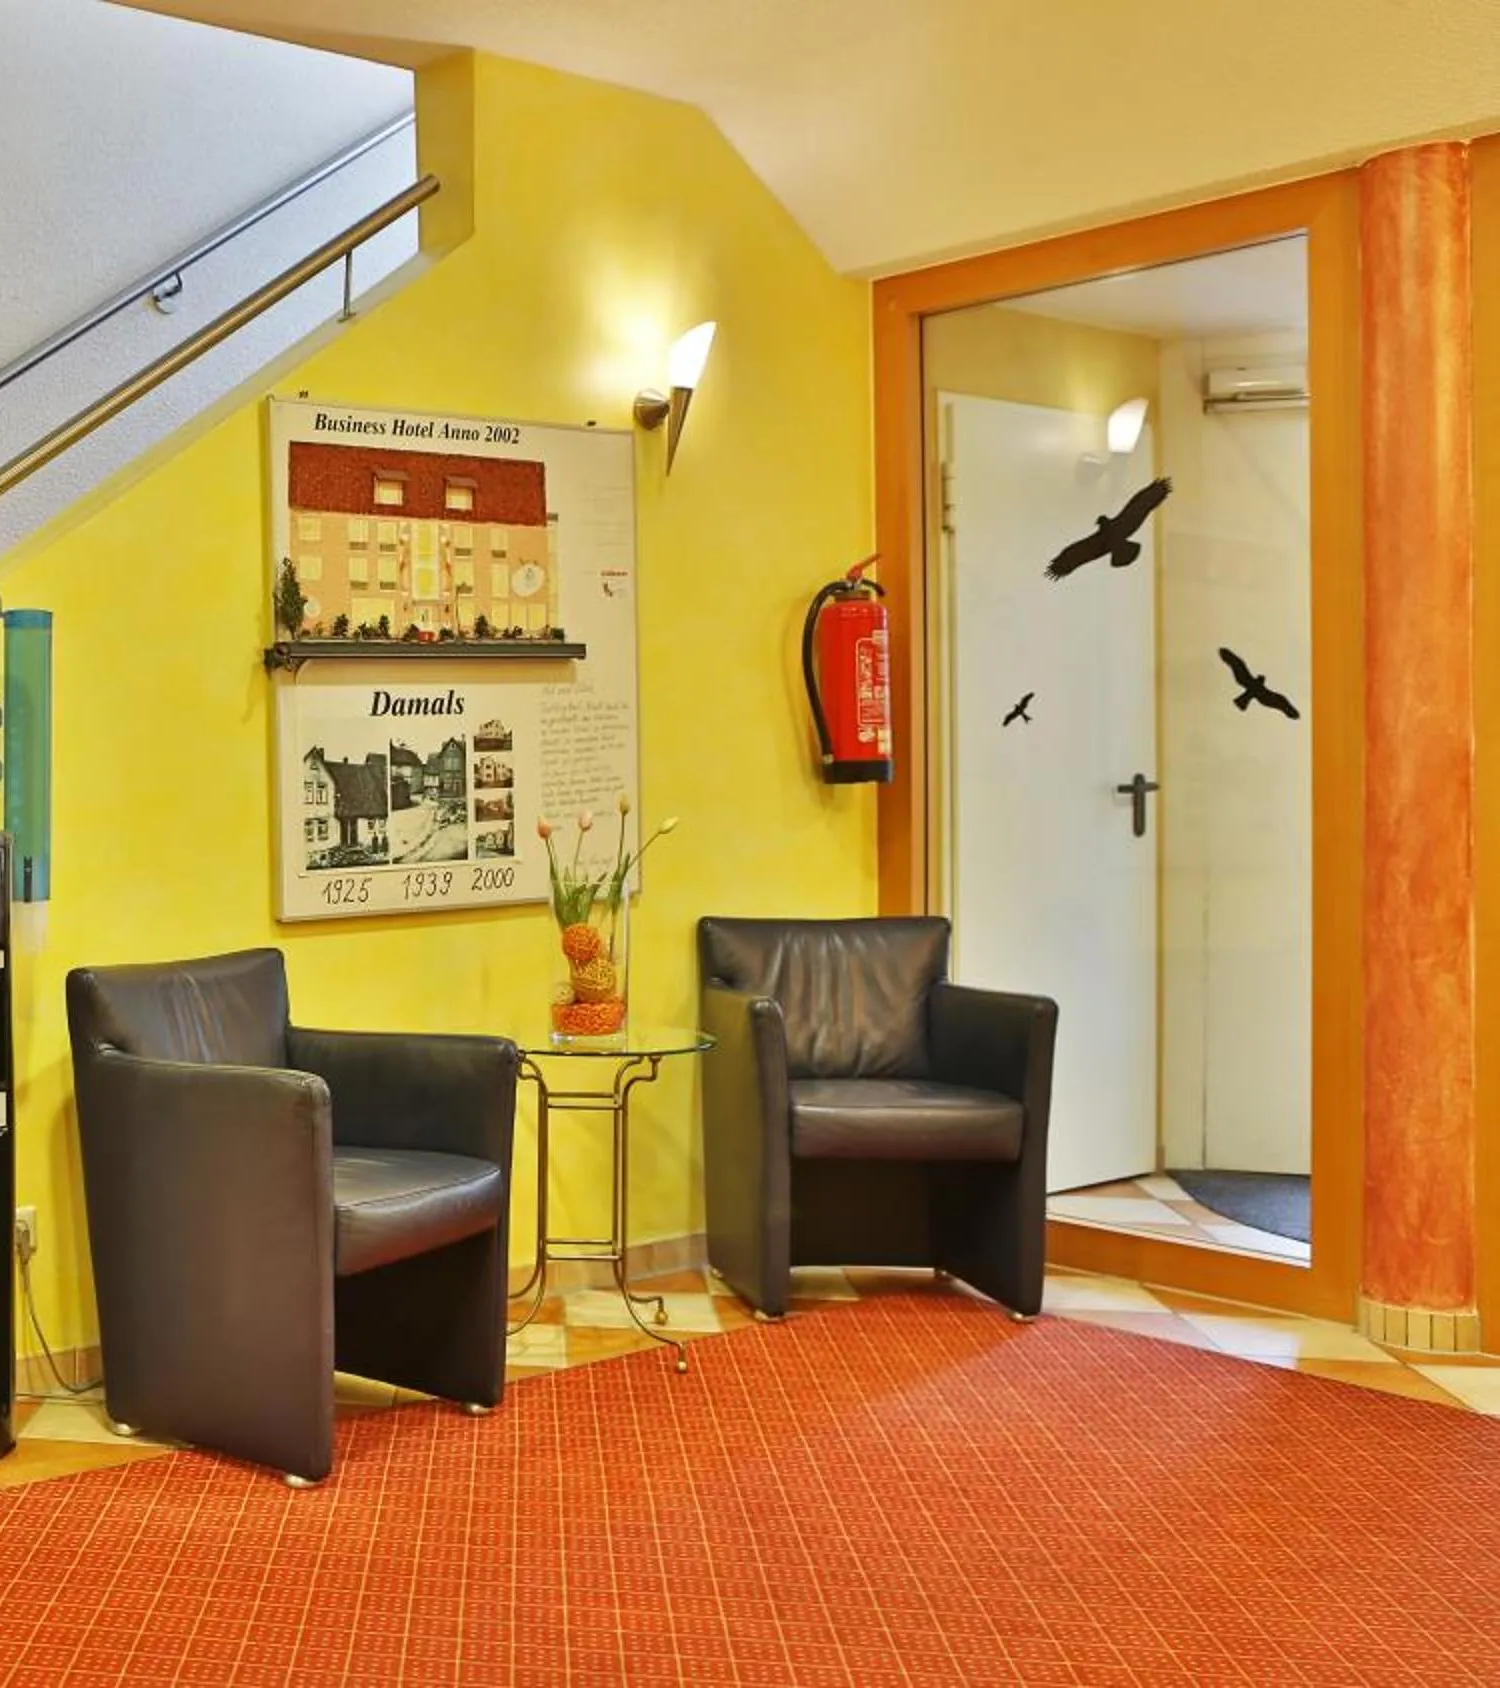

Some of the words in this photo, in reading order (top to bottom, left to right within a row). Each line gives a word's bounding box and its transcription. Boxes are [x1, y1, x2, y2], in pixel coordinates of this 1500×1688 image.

[314, 412, 386, 435] Business
[392, 418, 434, 439] Hotel
[438, 422, 480, 441] Anno
[484, 425, 520, 444] 2002
[370, 689, 465, 717] Damals
[322, 877, 373, 905] 1925
[403, 871, 453, 900] 1939
[471, 867, 515, 892] 2000
